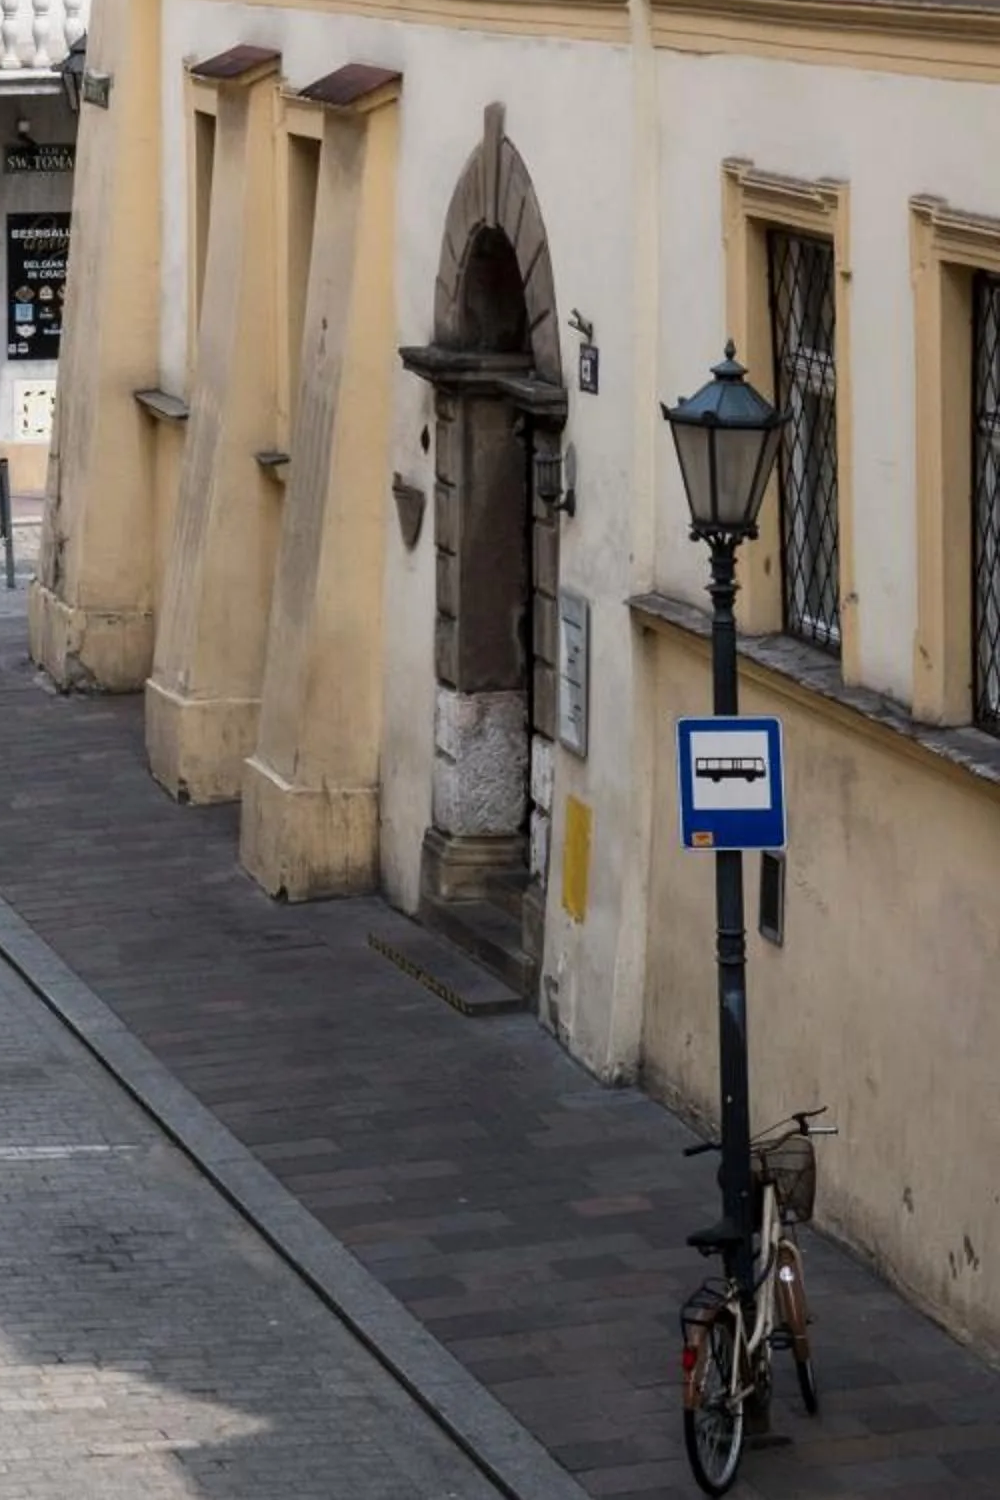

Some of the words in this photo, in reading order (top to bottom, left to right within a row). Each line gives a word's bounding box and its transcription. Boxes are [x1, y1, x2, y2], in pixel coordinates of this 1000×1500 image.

[33, 155, 73, 169] TOMA
[11, 228, 70, 239] BEERGALL
[23, 260, 64, 269] BELGIAN
[39, 270, 65, 279] CRAC
